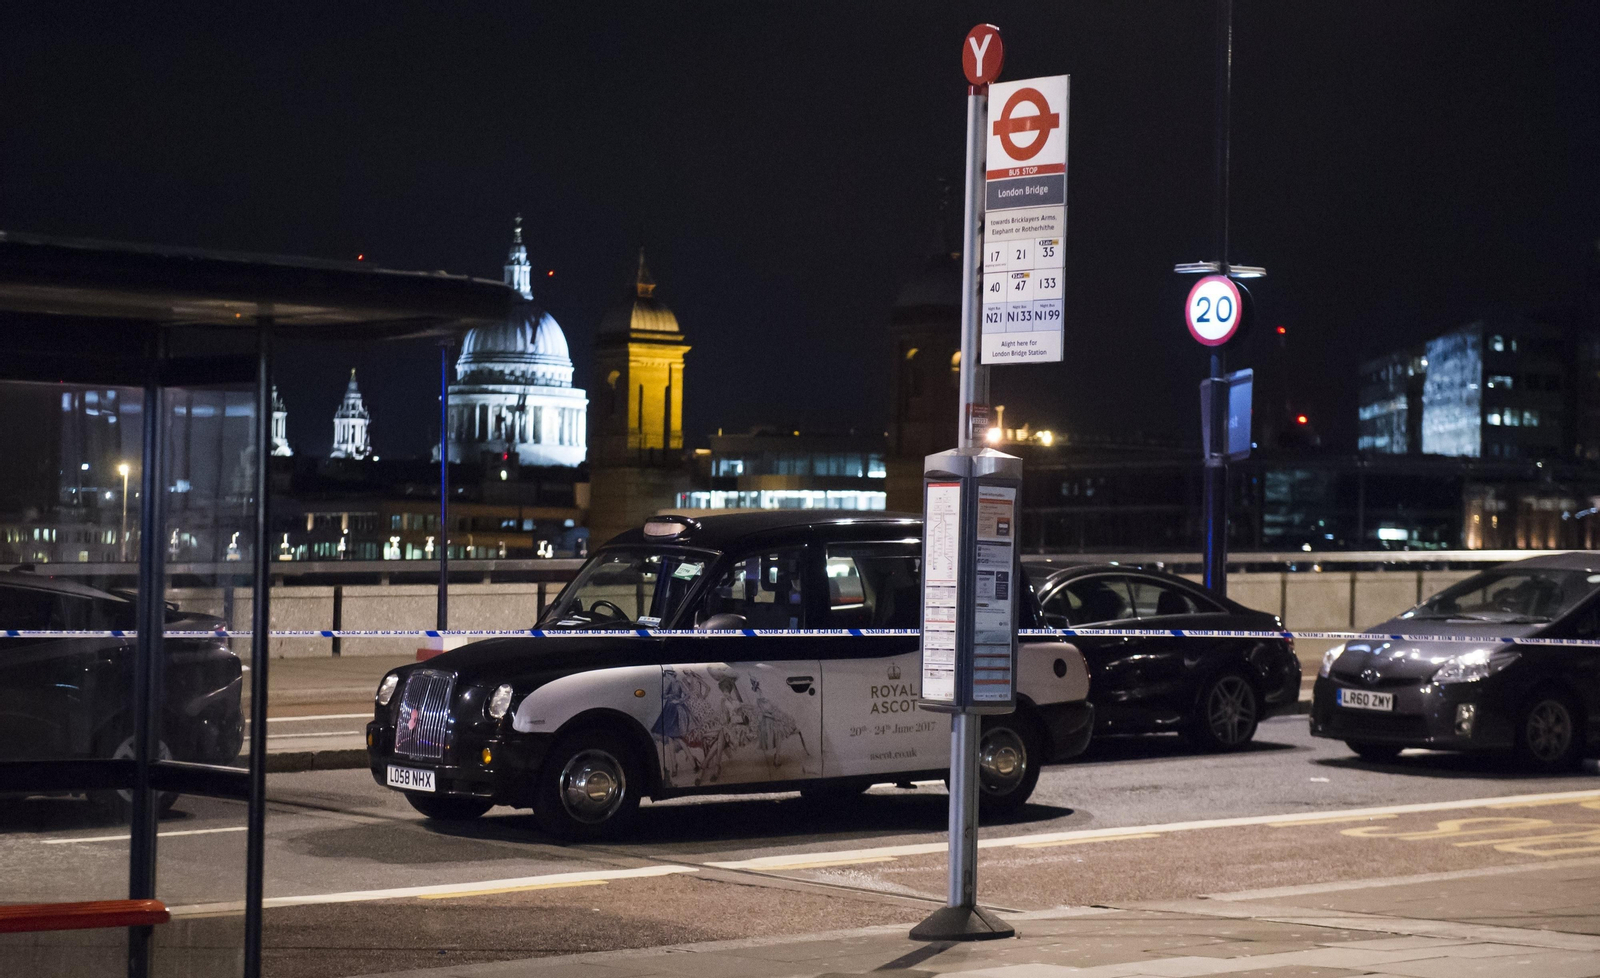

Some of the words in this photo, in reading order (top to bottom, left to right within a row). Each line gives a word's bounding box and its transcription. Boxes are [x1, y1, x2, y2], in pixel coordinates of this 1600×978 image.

[968, 34, 992, 77] Y
[1009, 168, 1020, 176] BUS
[1022, 166, 1038, 175] STOP
[998, 187, 1023, 197] London
[1026, 186, 1048, 195] Bridge
[991, 251, 1000, 262] 17
[1016, 249, 1026, 260] 21
[1042, 247, 1054, 257] 35
[990, 282, 1000, 292] 40
[1015, 280, 1026, 290] 47
[1040, 278, 1056, 289] 133
[1035, 310, 1060, 320] N199
[1196, 296, 1232, 323] 20
[986, 312, 1002, 323] N21
[1008, 311, 1032, 322] N133
[871, 684, 917, 698] ROYAL
[1343, 692, 1369, 706] LR60
[1372, 695, 1390, 708] ZMY
[870, 699, 918, 714] ASCOT
[850, 725, 867, 736] 20th
[874, 724, 891, 735] 24th
[892, 723, 913, 733] June
[915, 722, 936, 732] 2017
[870, 747, 917, 760] ascot.co.uk
[413, 770, 431, 788] NHX
